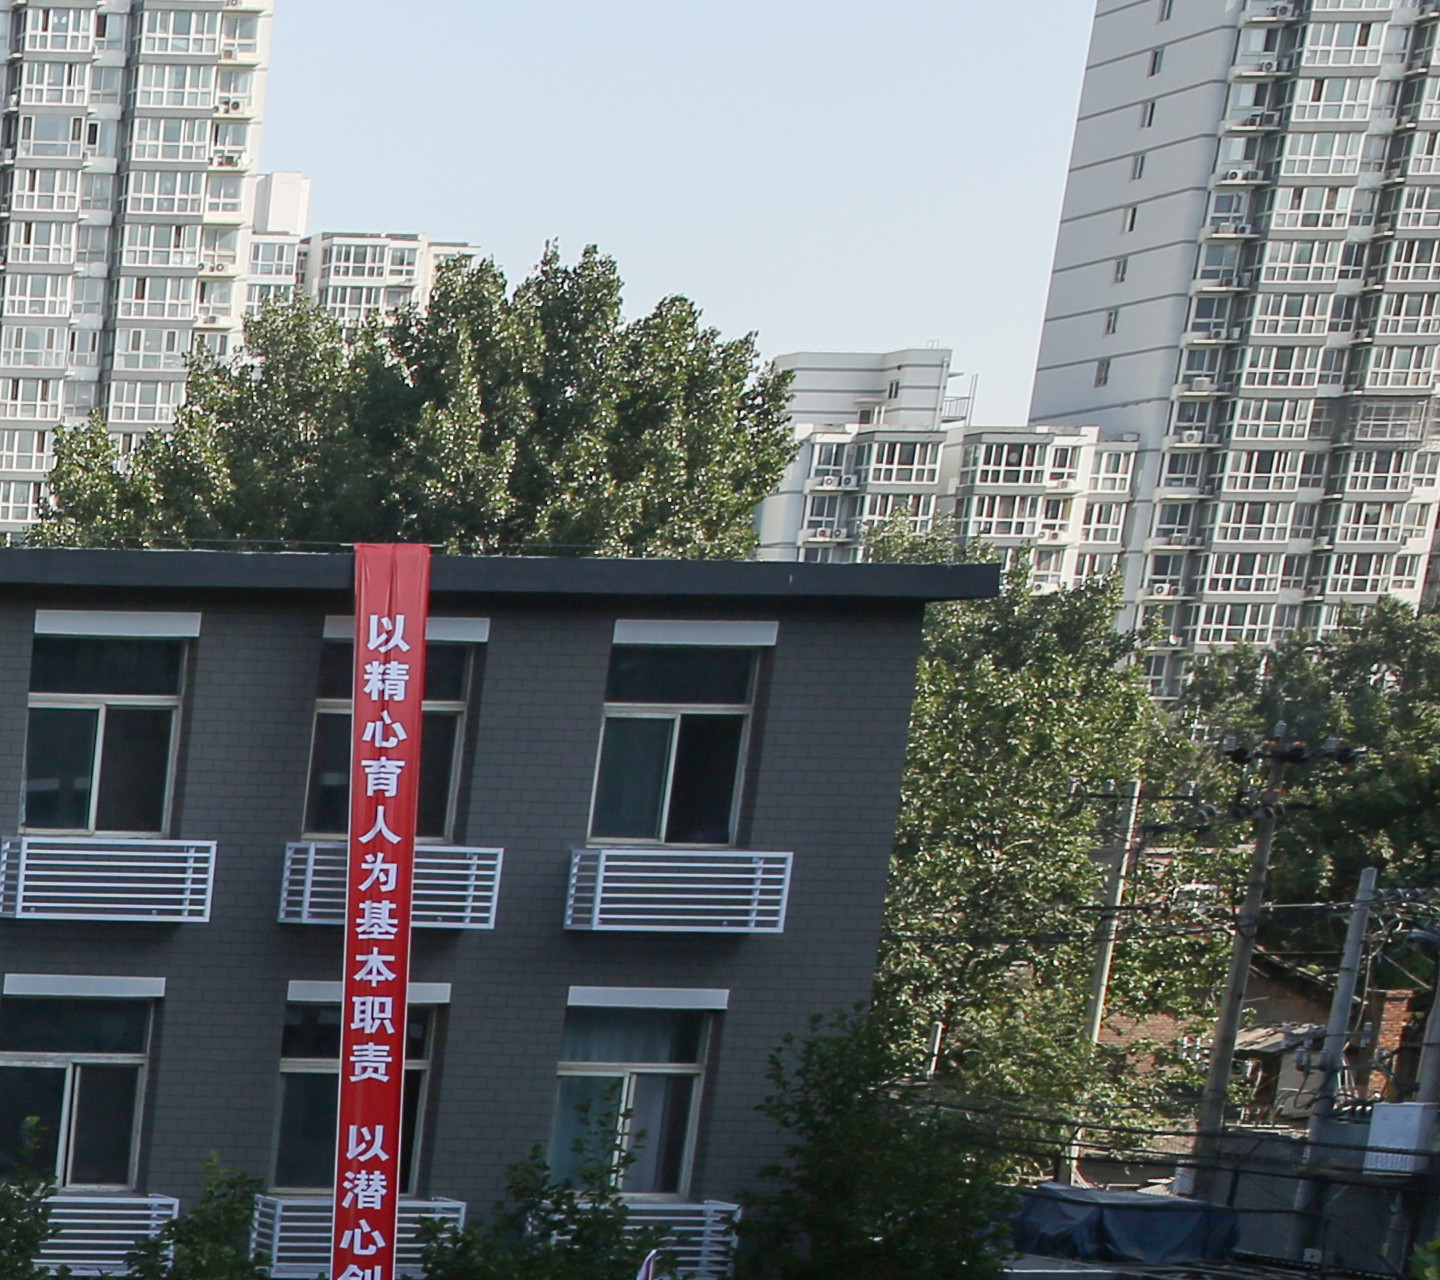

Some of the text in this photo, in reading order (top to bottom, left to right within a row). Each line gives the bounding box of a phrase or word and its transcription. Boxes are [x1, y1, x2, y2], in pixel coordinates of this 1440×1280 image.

[349, 613, 410, 1084] 以精心育人为基本职责
